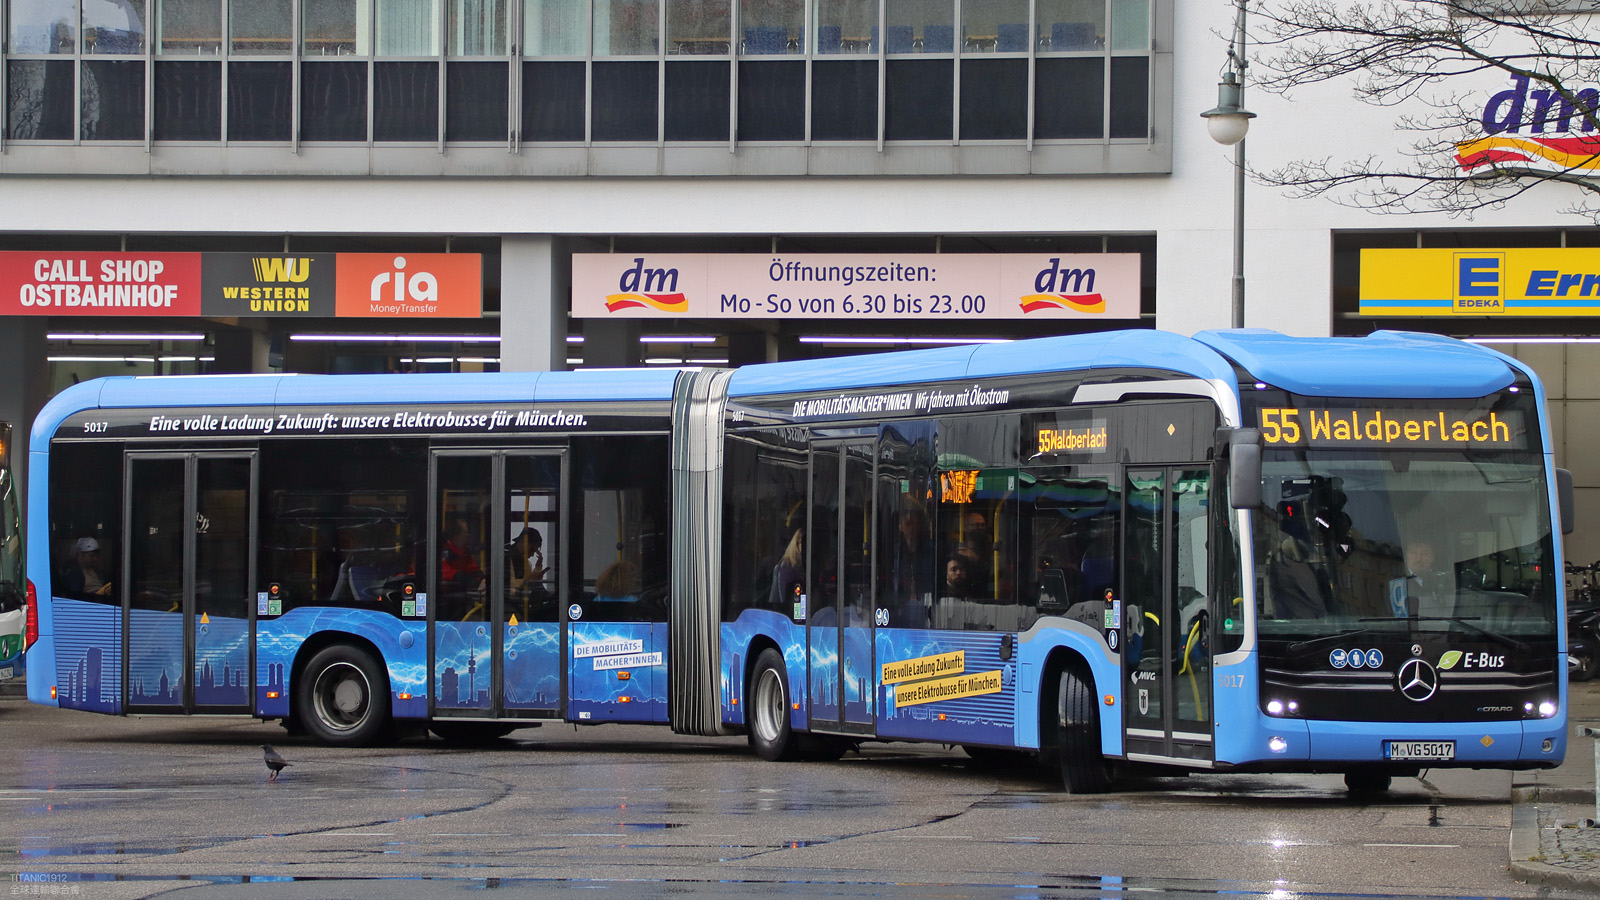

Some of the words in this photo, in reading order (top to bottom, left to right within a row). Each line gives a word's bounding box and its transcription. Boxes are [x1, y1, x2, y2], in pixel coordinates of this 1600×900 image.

[1483, 70, 1600, 134] dm
[34, 259, 95, 282] CALL
[100, 259, 164, 282] SHOP
[370, 256, 438, 301] ria
[619, 257, 679, 292] dm
[769, 258, 936, 286] Öffnungszeiten:
[1034, 257, 1096, 292] dm
[20, 284, 178, 307] OSTBAHNHOF
[223, 287, 309, 299] WESTERN
[799, 299, 835, 313] von
[842, 295, 886, 313] 6.30
[893, 294, 922, 313] bis
[929, 295, 986, 313] 23.00
[250, 300, 309, 312] UNION
[370, 304, 438, 315] MoneyTransfer
[792, 401, 806, 417] DIE
[915, 392, 928, 409] Wir
[927, 390, 955, 413] fahren
[955, 388, 968, 407] mit
[969, 384, 1009, 406] Ökostrom
[84, 421, 108, 433] 5017
[149, 416, 180, 431] Eine
[184, 415, 218, 431] volle
[221, 414, 274, 433] Ladung
[276, 413, 338, 432] Zukunft:
[341, 415, 389, 429] unsere
[393, 411, 487, 428] Elektrobusse
[488, 410, 513, 430] für
[515, 410, 588, 426] München.
[1261, 408, 1301, 443] 55
[1310, 410, 1510, 442] Waldperlach
[577, 646, 590, 655] DIE
[591, 641, 641, 654] MOBILITÄTS-
[884, 667, 897, 681] Eine
[897, 664, 912, 678] volle
[913, 661, 935, 676] Ladung
[936, 655, 963, 672] Zukunft:
[1464, 652, 1505, 668] E-Bus
[1138, 671, 1156, 681] MVG
[1218, 674, 1245, 688] 5017
[897, 690, 917, 703] unsere
[918, 682, 957, 700] Elektrobusse
[957, 679, 967, 694] für
[968, 675, 1000, 692] München.
[1391, 744, 1399, 756] M
